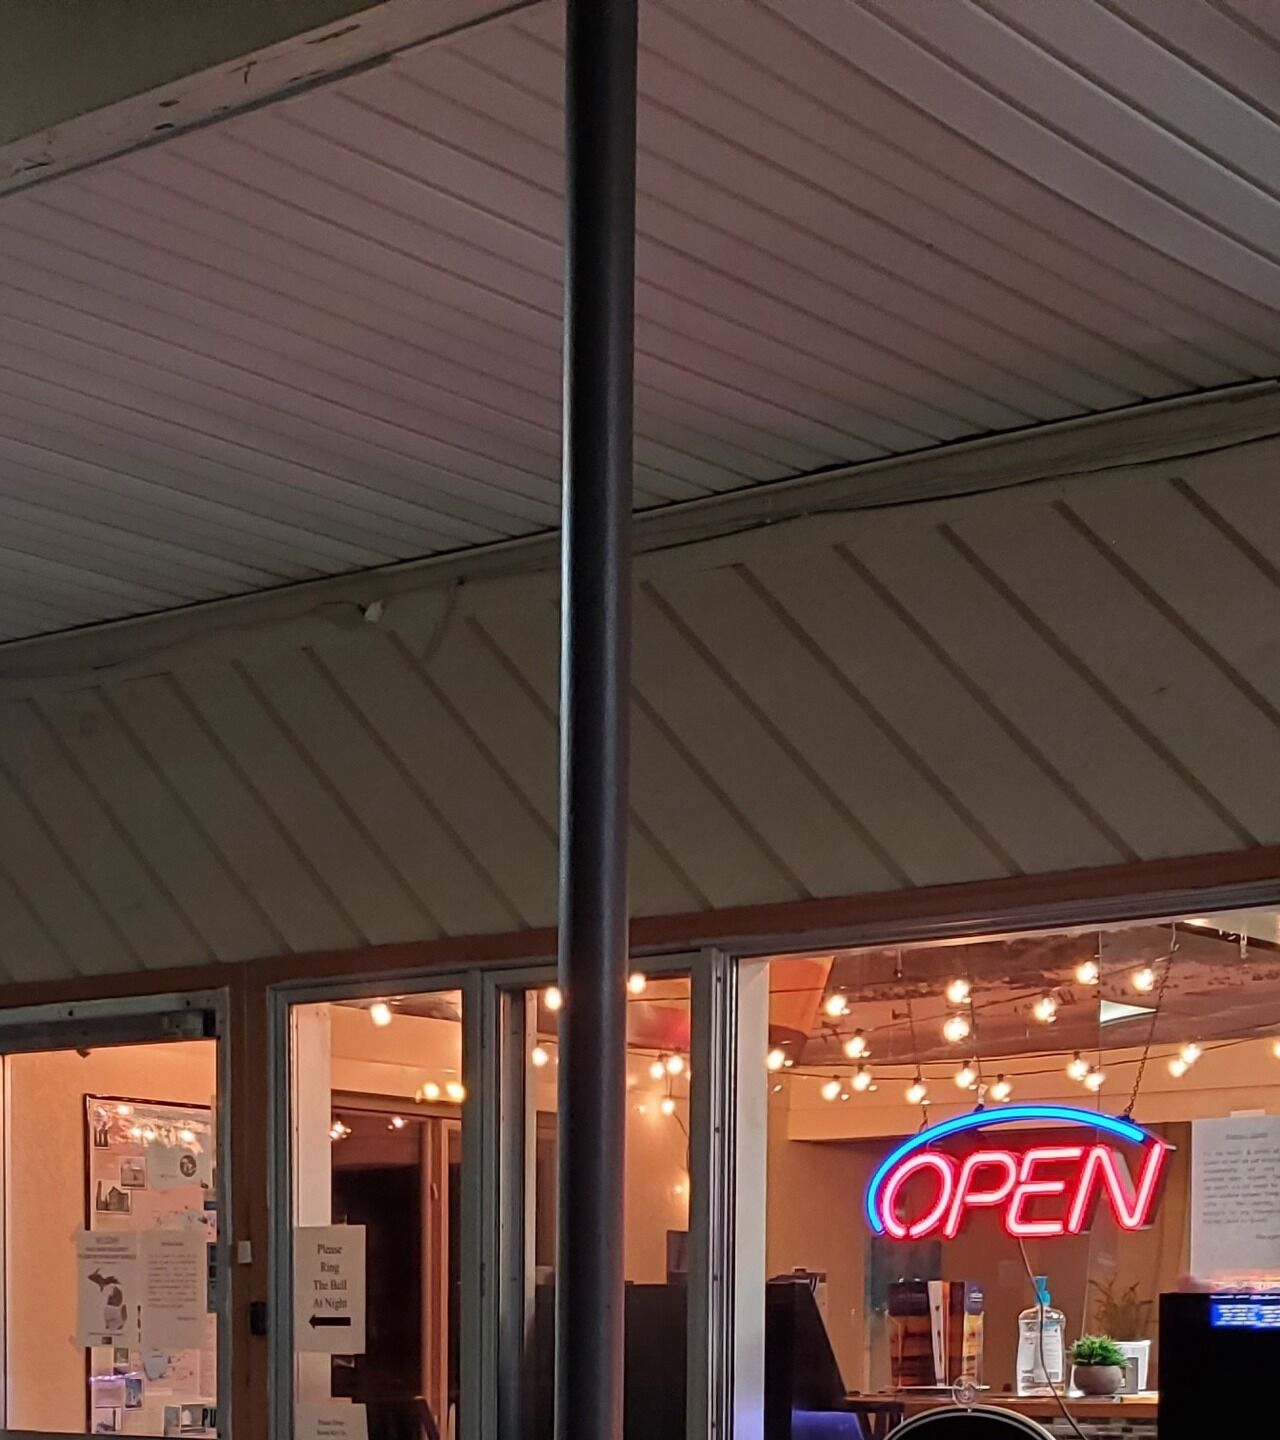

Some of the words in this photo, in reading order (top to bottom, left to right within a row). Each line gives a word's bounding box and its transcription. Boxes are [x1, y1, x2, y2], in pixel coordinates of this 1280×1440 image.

[882, 1140, 1165, 1238] OPEN
[317, 1243, 343, 1255] Please
[320, 1261, 340, 1275] Ring
[313, 1279, 328, 1291] The
[330, 1279, 347, 1291] Bell
[313, 1298, 323, 1309] At
[325, 1297, 347, 1311] Night
